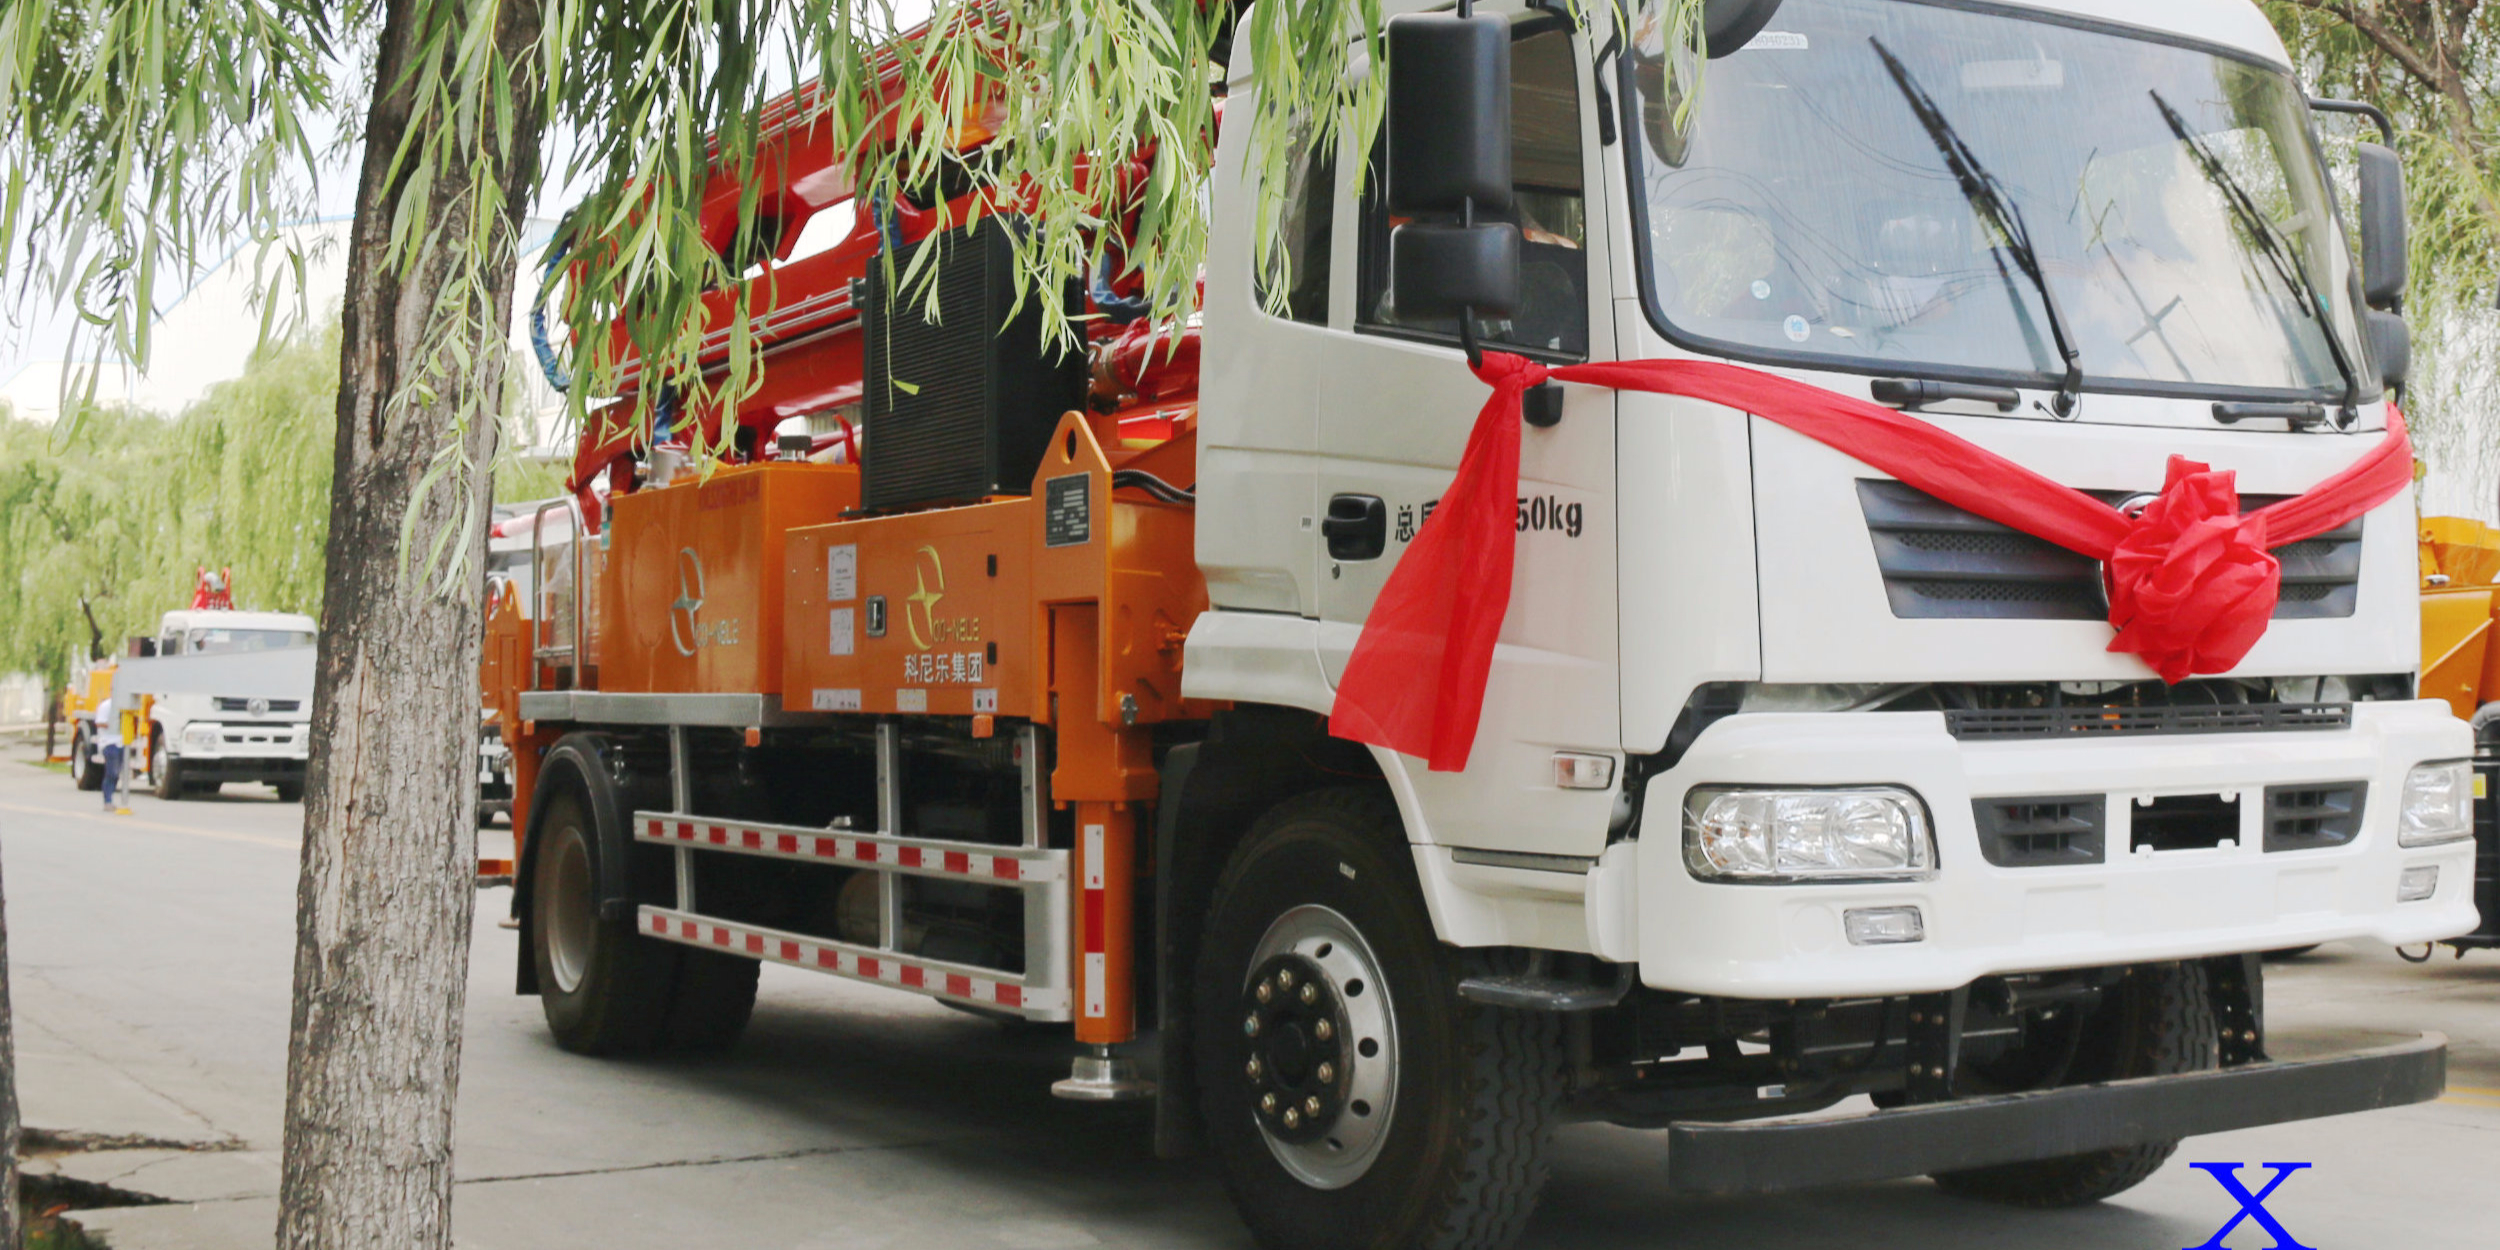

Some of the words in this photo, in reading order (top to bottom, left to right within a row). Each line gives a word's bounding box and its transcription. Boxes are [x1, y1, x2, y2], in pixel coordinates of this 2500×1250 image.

[933, 617, 980, 642] CO-NELE
[904, 651, 983, 684] 科尼乐集团
